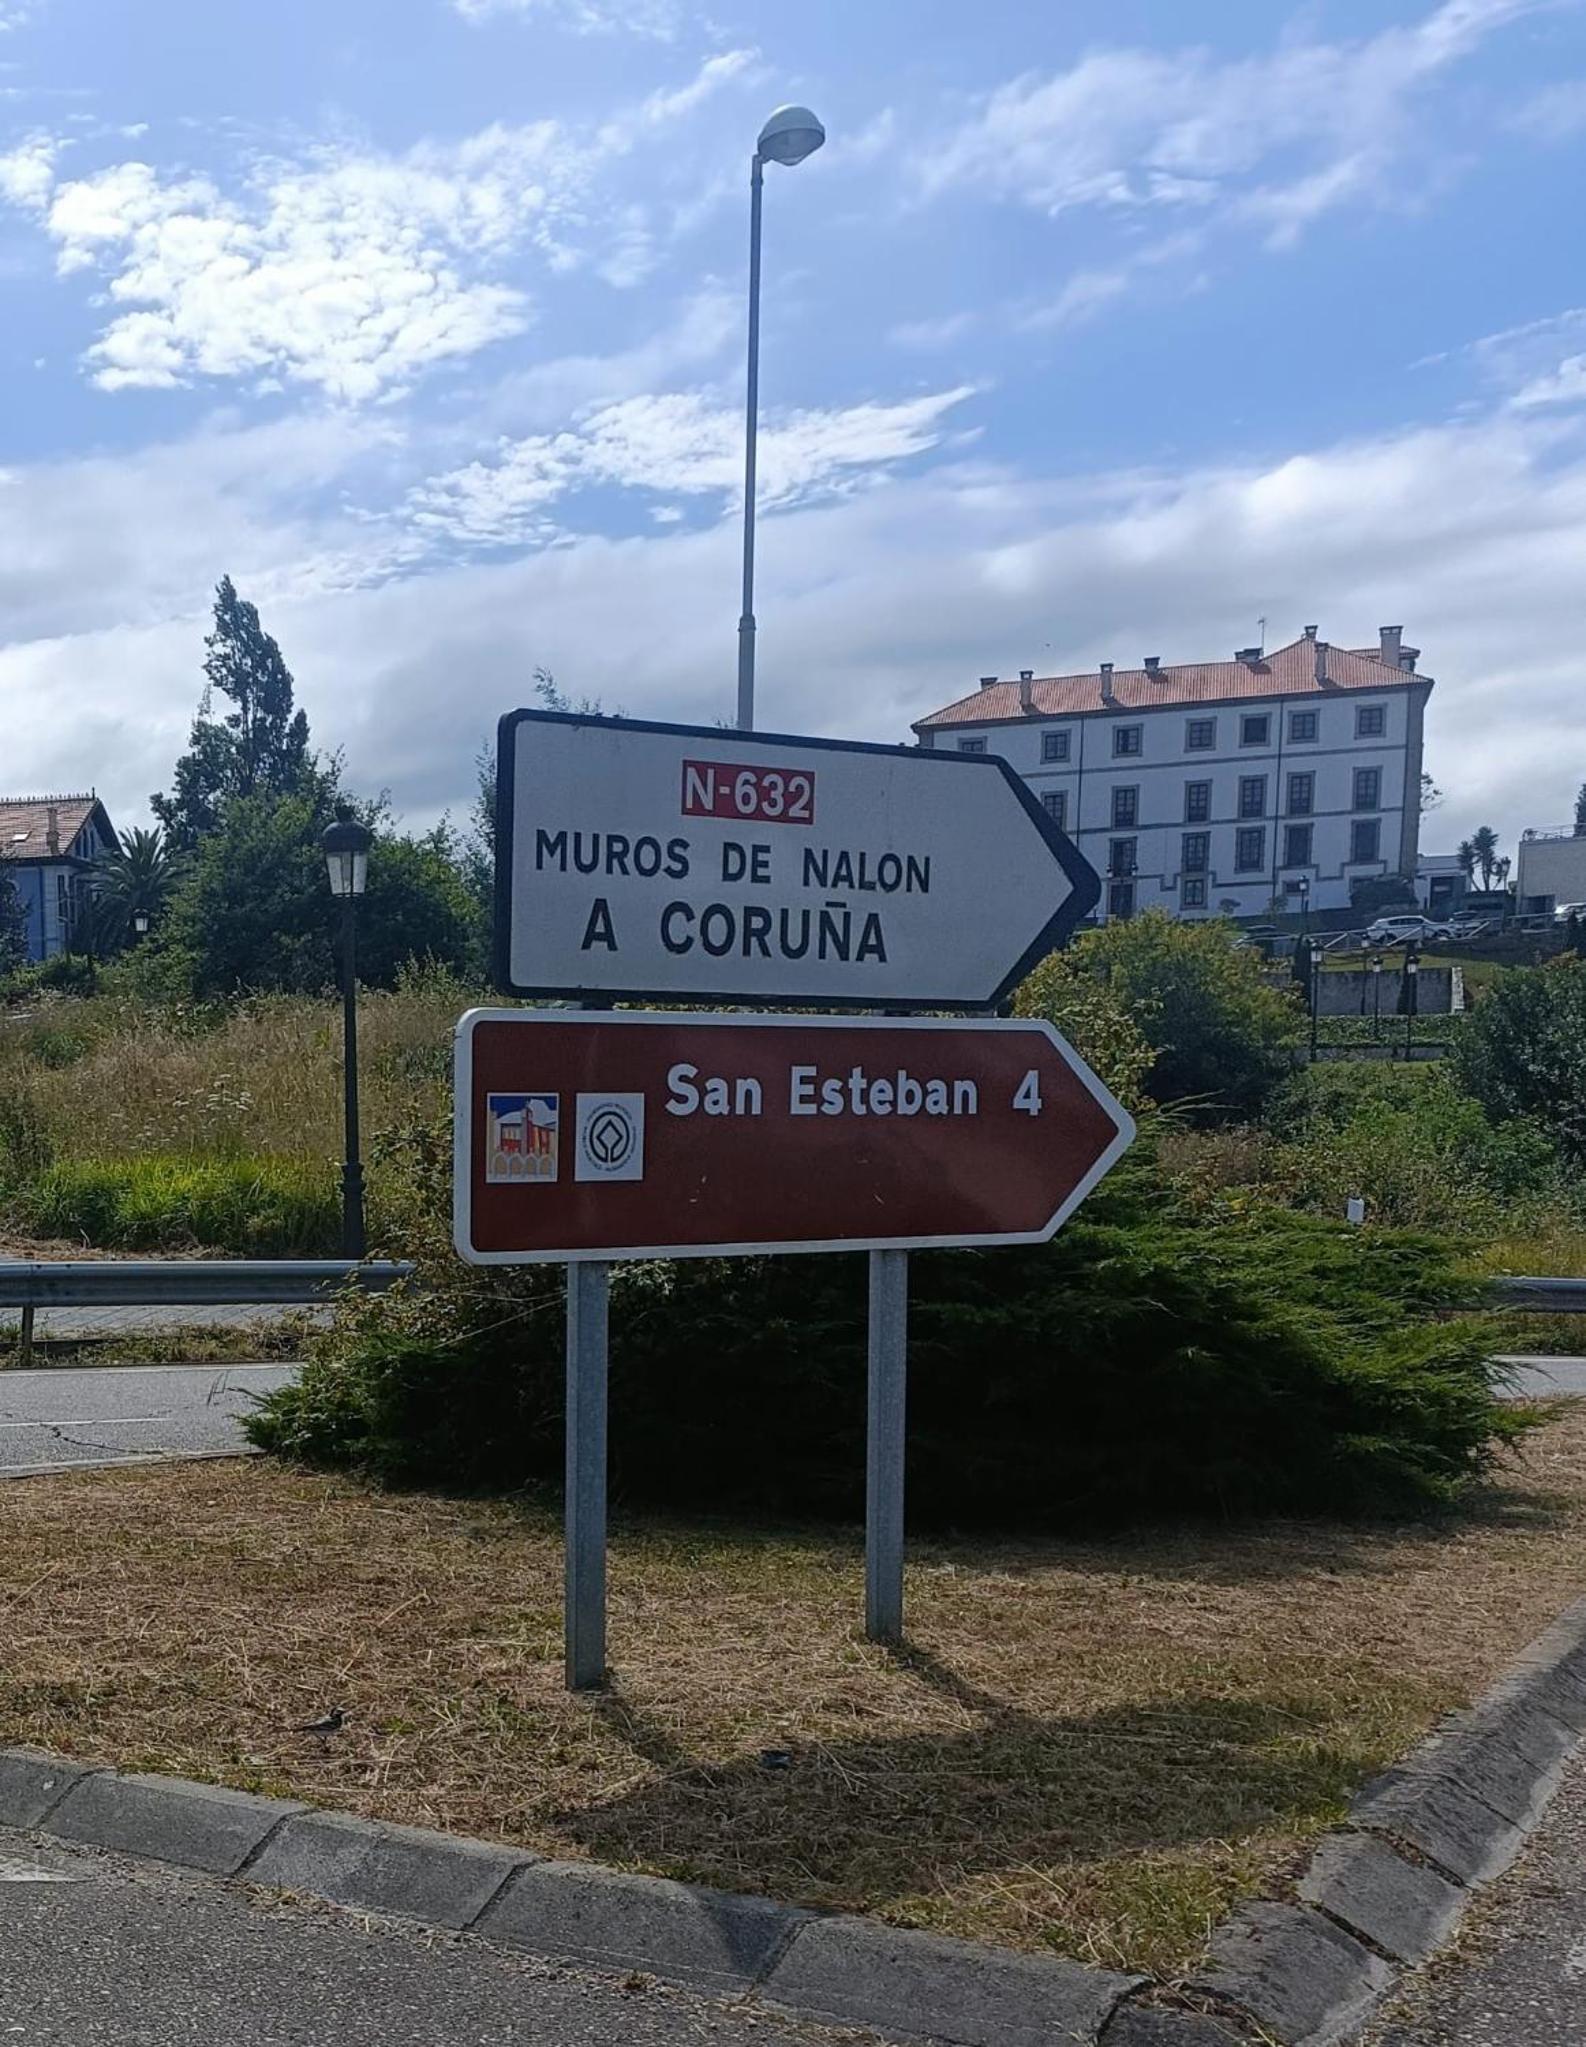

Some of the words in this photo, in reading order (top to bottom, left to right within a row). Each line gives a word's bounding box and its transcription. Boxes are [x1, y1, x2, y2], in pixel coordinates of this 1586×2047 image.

[685, 767, 812, 819] N-632
[536, 829, 690, 879] MUROS
[721, 842, 771, 884] DE
[802, 849, 931, 893] NALON
[581, 898, 618, 952] A
[660, 901, 888, 963] CORUÑA
[665, 1063, 762, 1116] San
[789, 1065, 978, 1116] Esteban
[1012, 1069, 1043, 1116] 4
